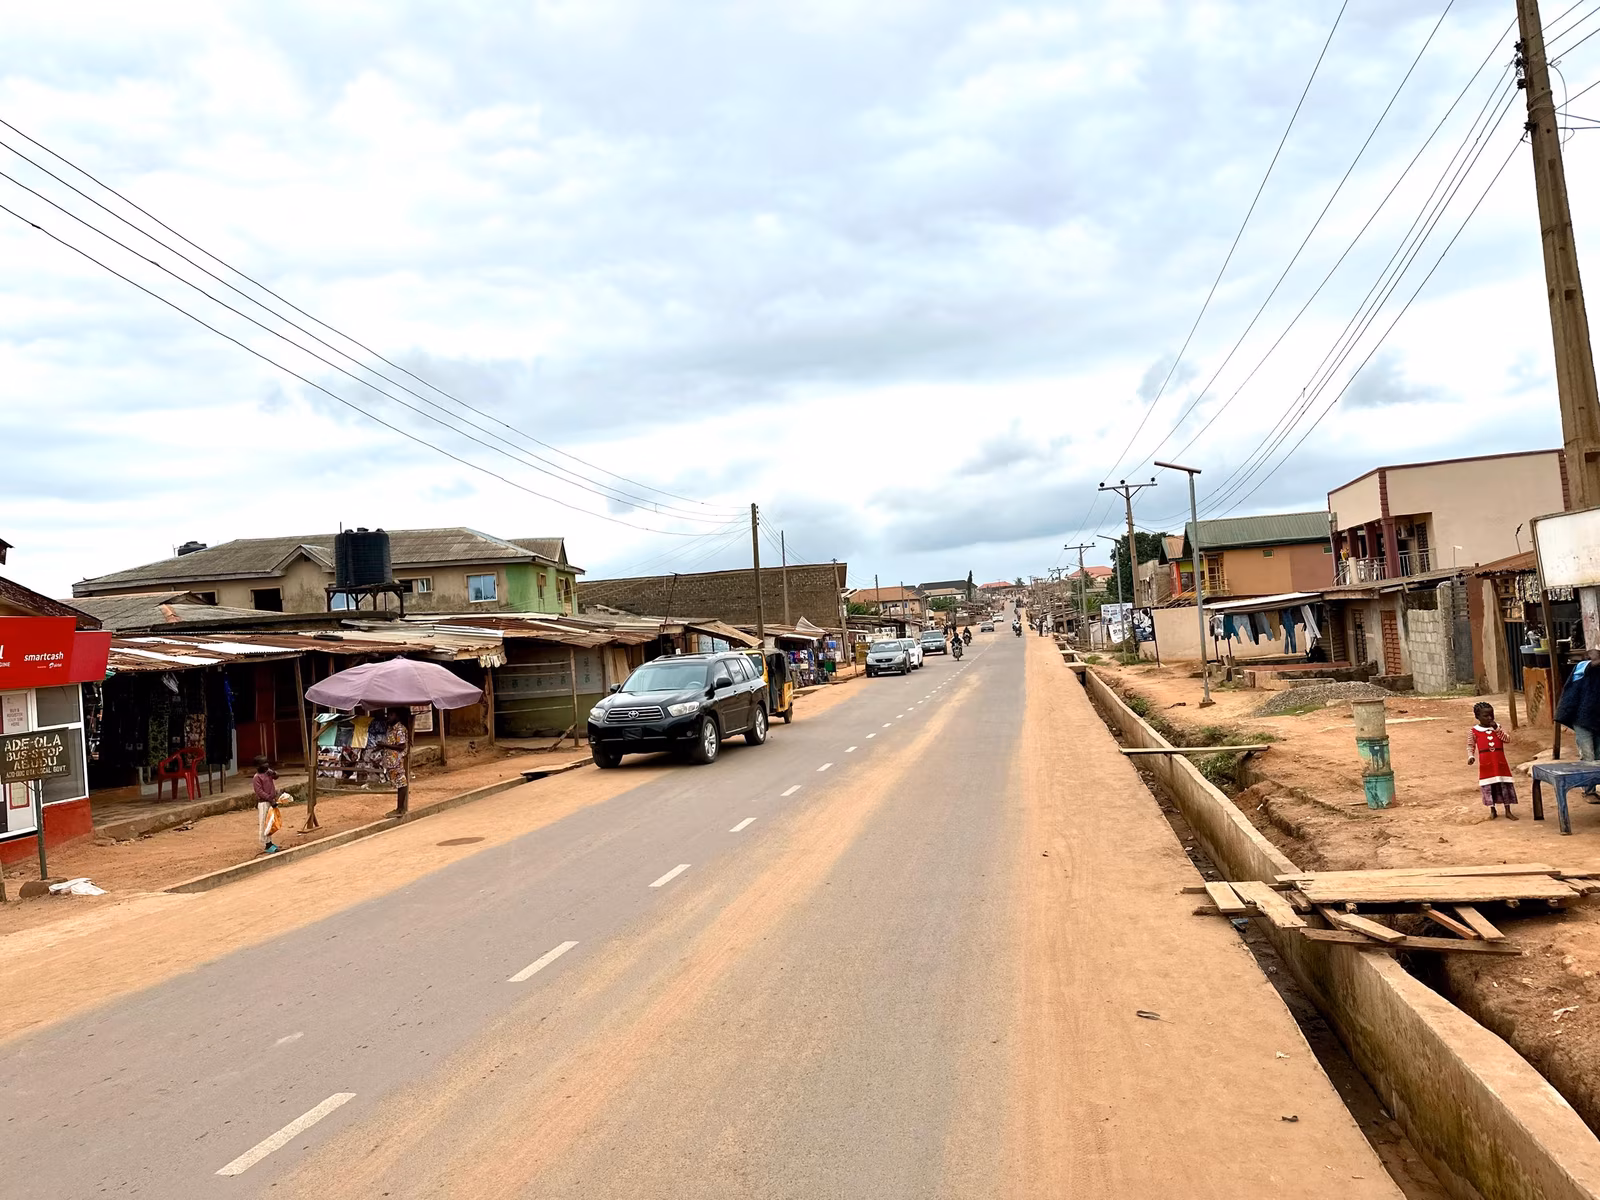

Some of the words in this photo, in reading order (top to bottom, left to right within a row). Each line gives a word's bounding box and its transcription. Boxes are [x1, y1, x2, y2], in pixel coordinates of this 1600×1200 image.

[24, 651, 64, 662] smartcash
[4, 734, 61, 752] ADE-OLA
[6, 746, 63, 762] BUS-STOP
